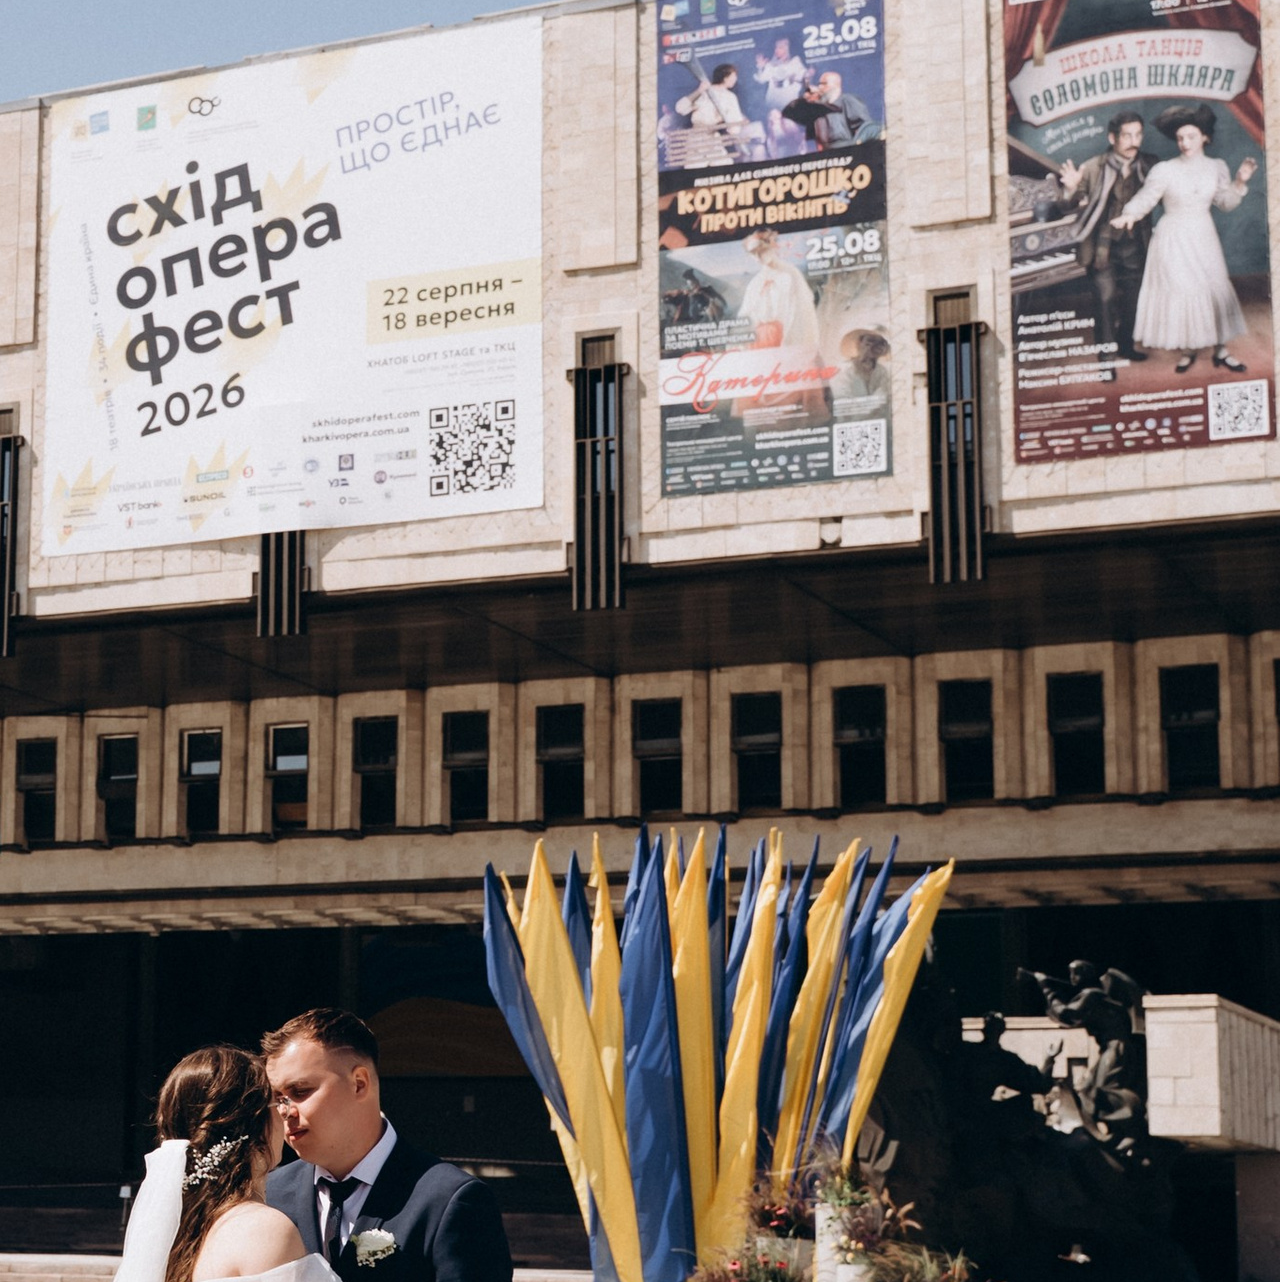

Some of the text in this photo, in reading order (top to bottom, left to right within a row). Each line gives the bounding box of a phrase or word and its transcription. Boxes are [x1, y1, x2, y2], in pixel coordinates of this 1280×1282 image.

[803, 16, 877, 48] 25.08
[1059, 38, 1204, 75] ШКОЛА ТАНЦІВ
[1030, 64, 1236, 117] СОЛОМОНА ШКЛЯРА
[336, 91, 460, 148] ПРОСТІР,
[340, 104, 501, 174] ЩО ЄДНАЄ
[107, 160, 263, 246] схід
[677, 164, 872, 215] КОТИГОРОШКО
[700, 207, 763, 233] ПРОТИ
[116, 201, 342, 310] опера
[805, 228, 880, 260] 25.08
[383, 286, 409, 307] 22
[417, 277, 504, 304] серпня
[125, 280, 301, 386] фест
[382, 302, 516, 332] 18 вересня
[366, 355, 409, 369] ХНАТОБ
[412, 351, 438, 364] LOFT
[442, 347, 476, 361] STAGE
[663, 349, 841, 414] Катерина
[137, 372, 246, 438] 2026
[312, 409, 420, 429] skhidoperafest.com
[302, 427, 410, 444] kharkivopera.com.ua
